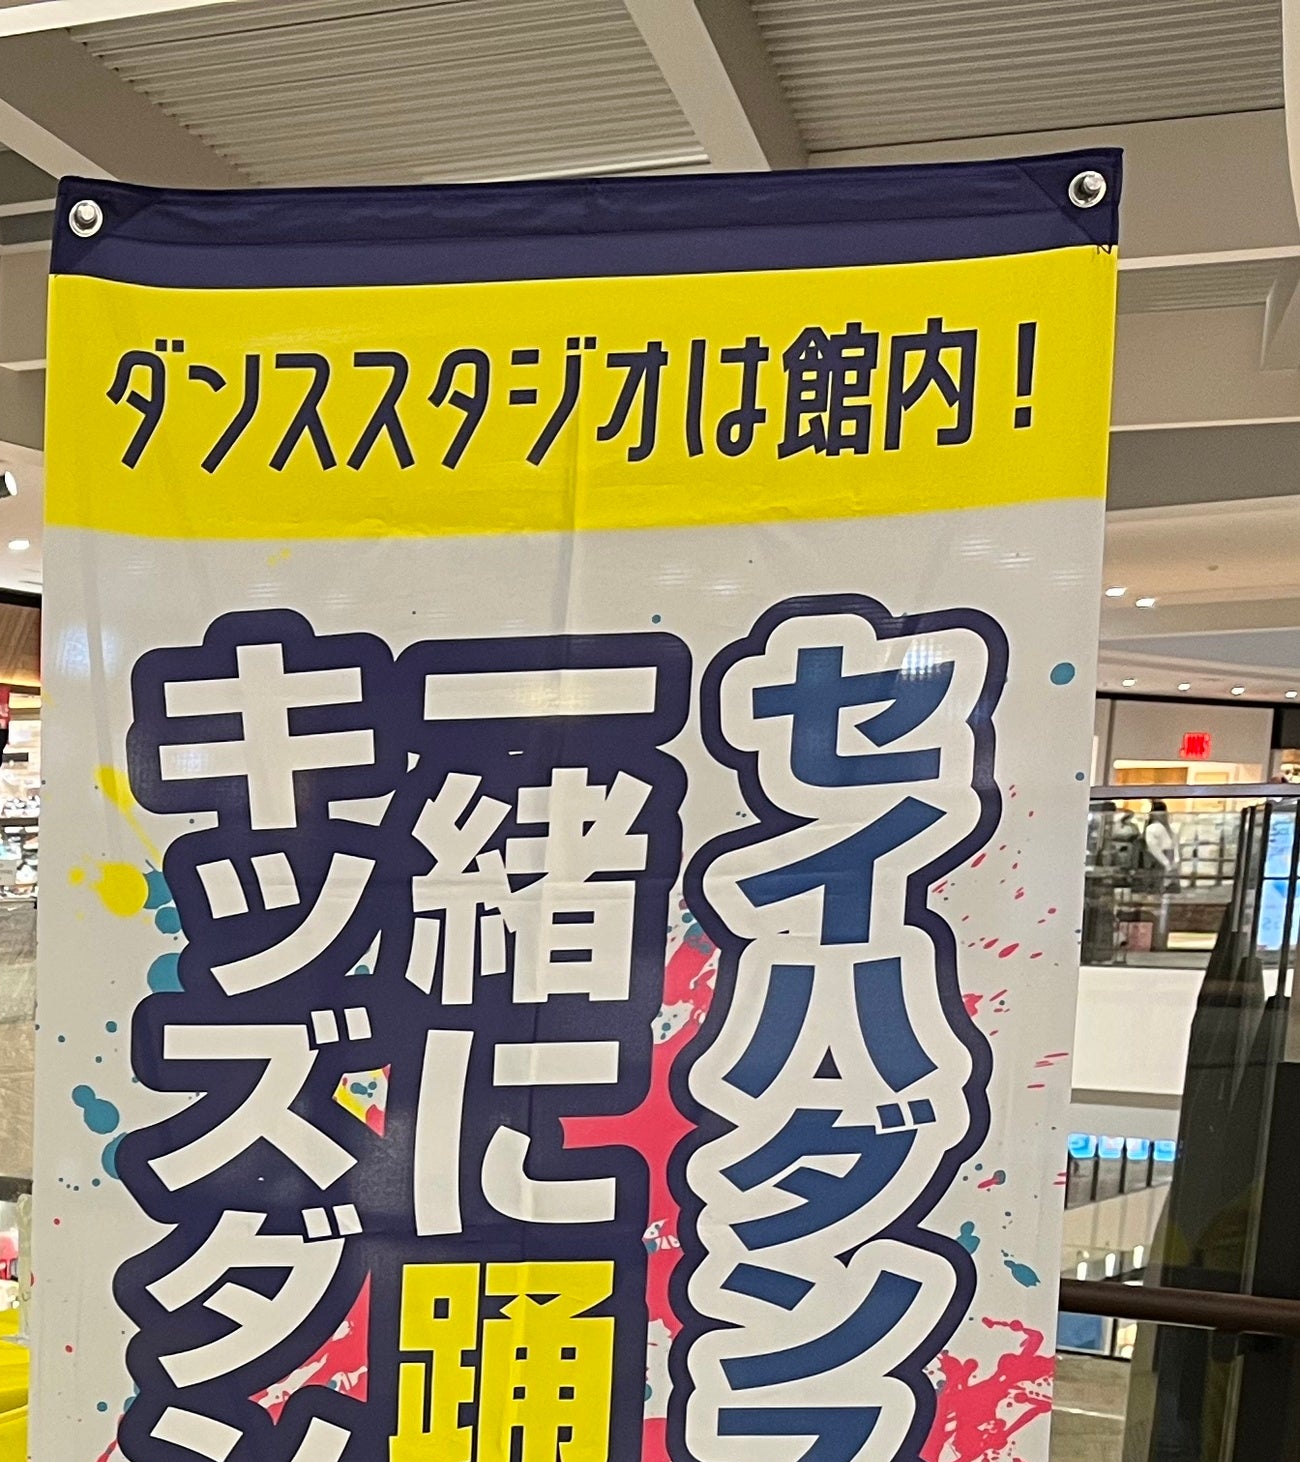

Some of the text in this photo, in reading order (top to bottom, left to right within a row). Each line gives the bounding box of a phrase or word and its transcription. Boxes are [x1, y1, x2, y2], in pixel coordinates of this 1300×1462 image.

[105, 316, 1041, 474] ダンススタジオは館内!
